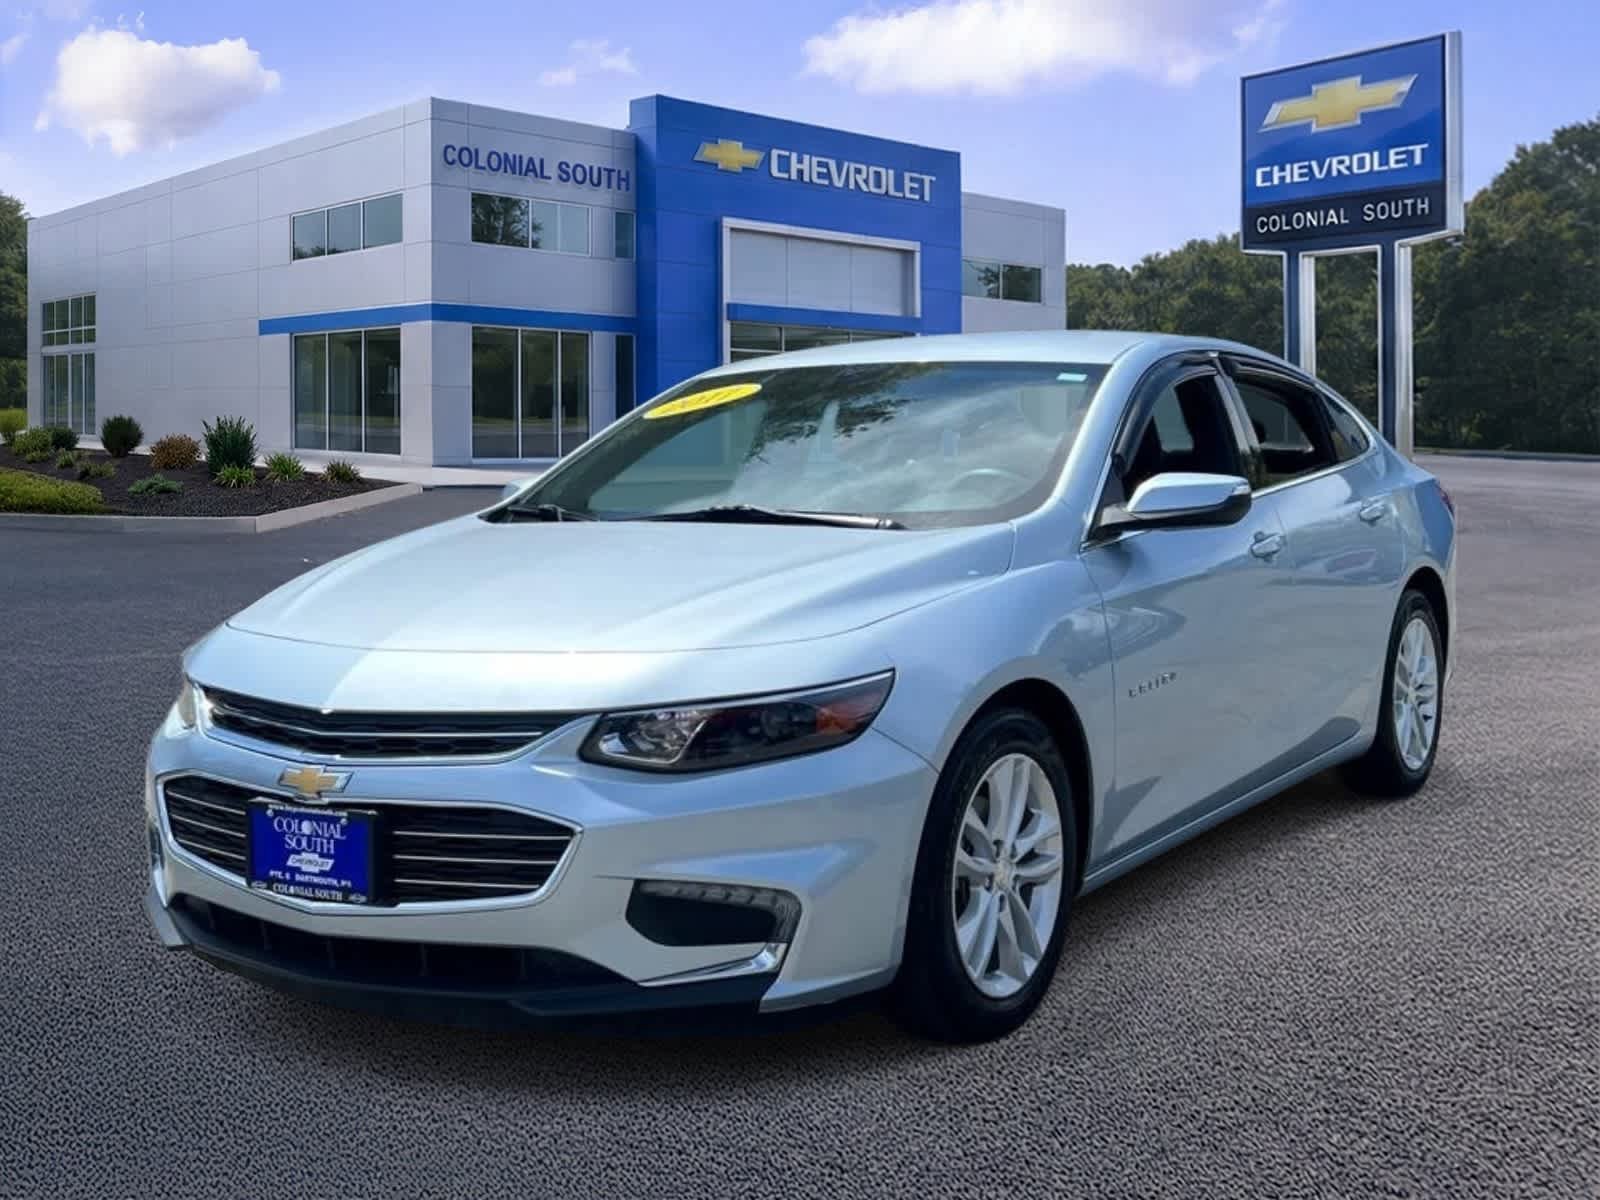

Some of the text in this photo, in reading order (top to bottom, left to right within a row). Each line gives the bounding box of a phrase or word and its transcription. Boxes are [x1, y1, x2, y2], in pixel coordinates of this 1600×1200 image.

[443, 144, 631, 192] COLONIAL SOUTH
[770, 147, 937, 202] CHEVROLET
[1255, 143, 1429, 187] CHEVROLET
[1256, 196, 1430, 234] COLONIAL SOUTH
[273, 816, 346, 839] COLONIAL
[284, 834, 335, 855] SOUTH
[314, 887, 343, 901] SOUTH
